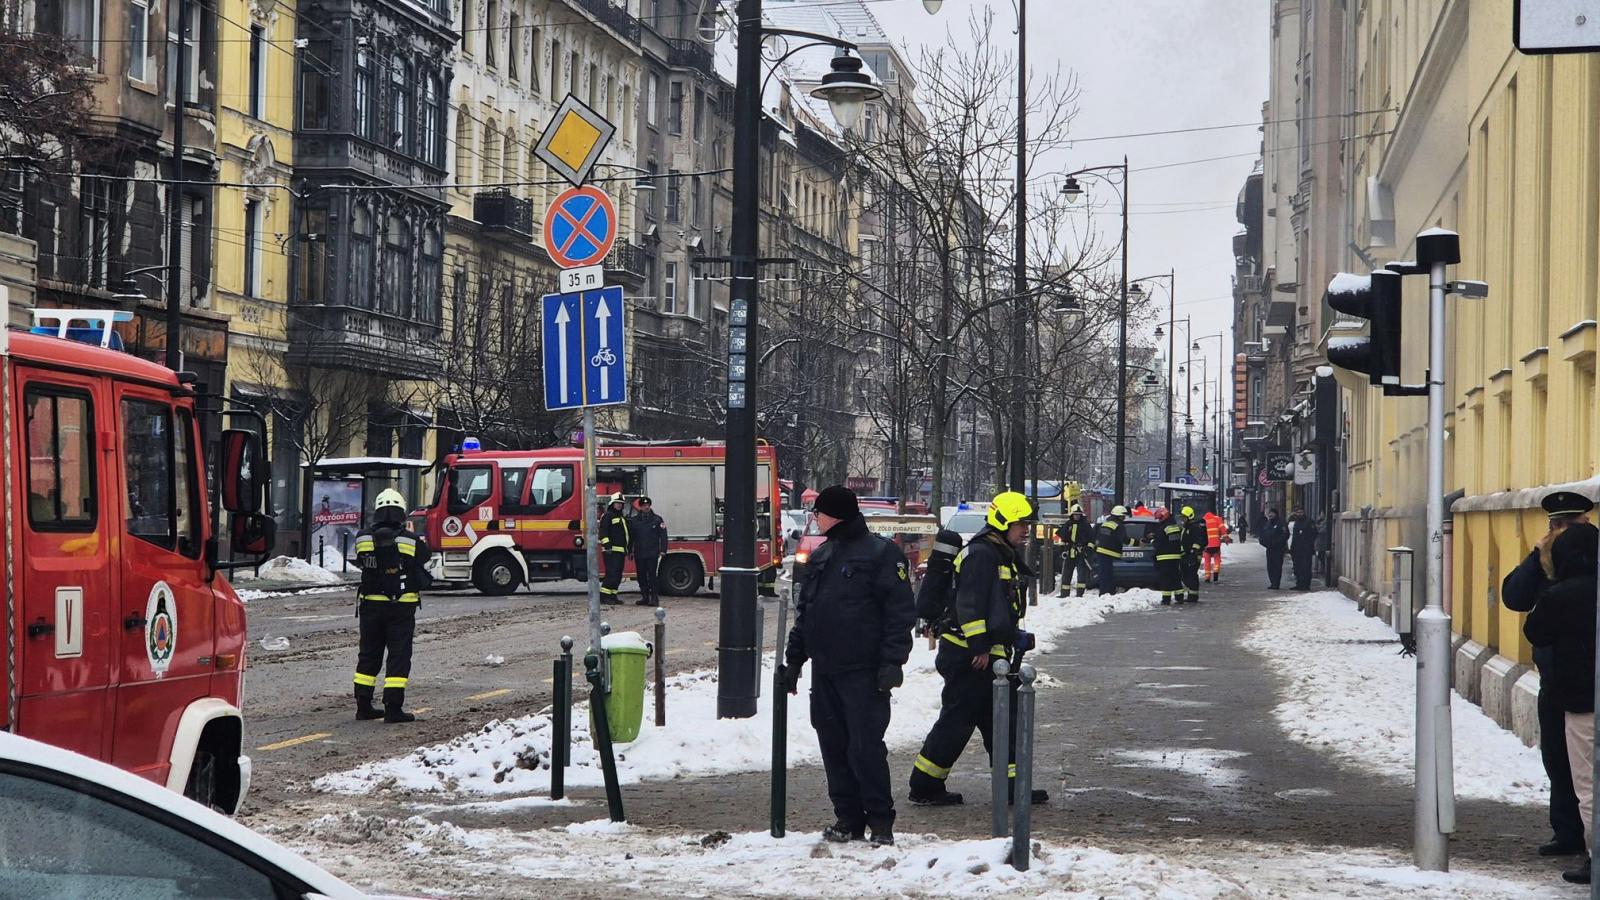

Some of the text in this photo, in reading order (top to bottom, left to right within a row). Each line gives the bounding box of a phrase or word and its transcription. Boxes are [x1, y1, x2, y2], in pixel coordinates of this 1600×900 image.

[568, 273, 595, 287] 35 m
[481, 508, 490, 519] IX
[65, 599, 72, 645] V
